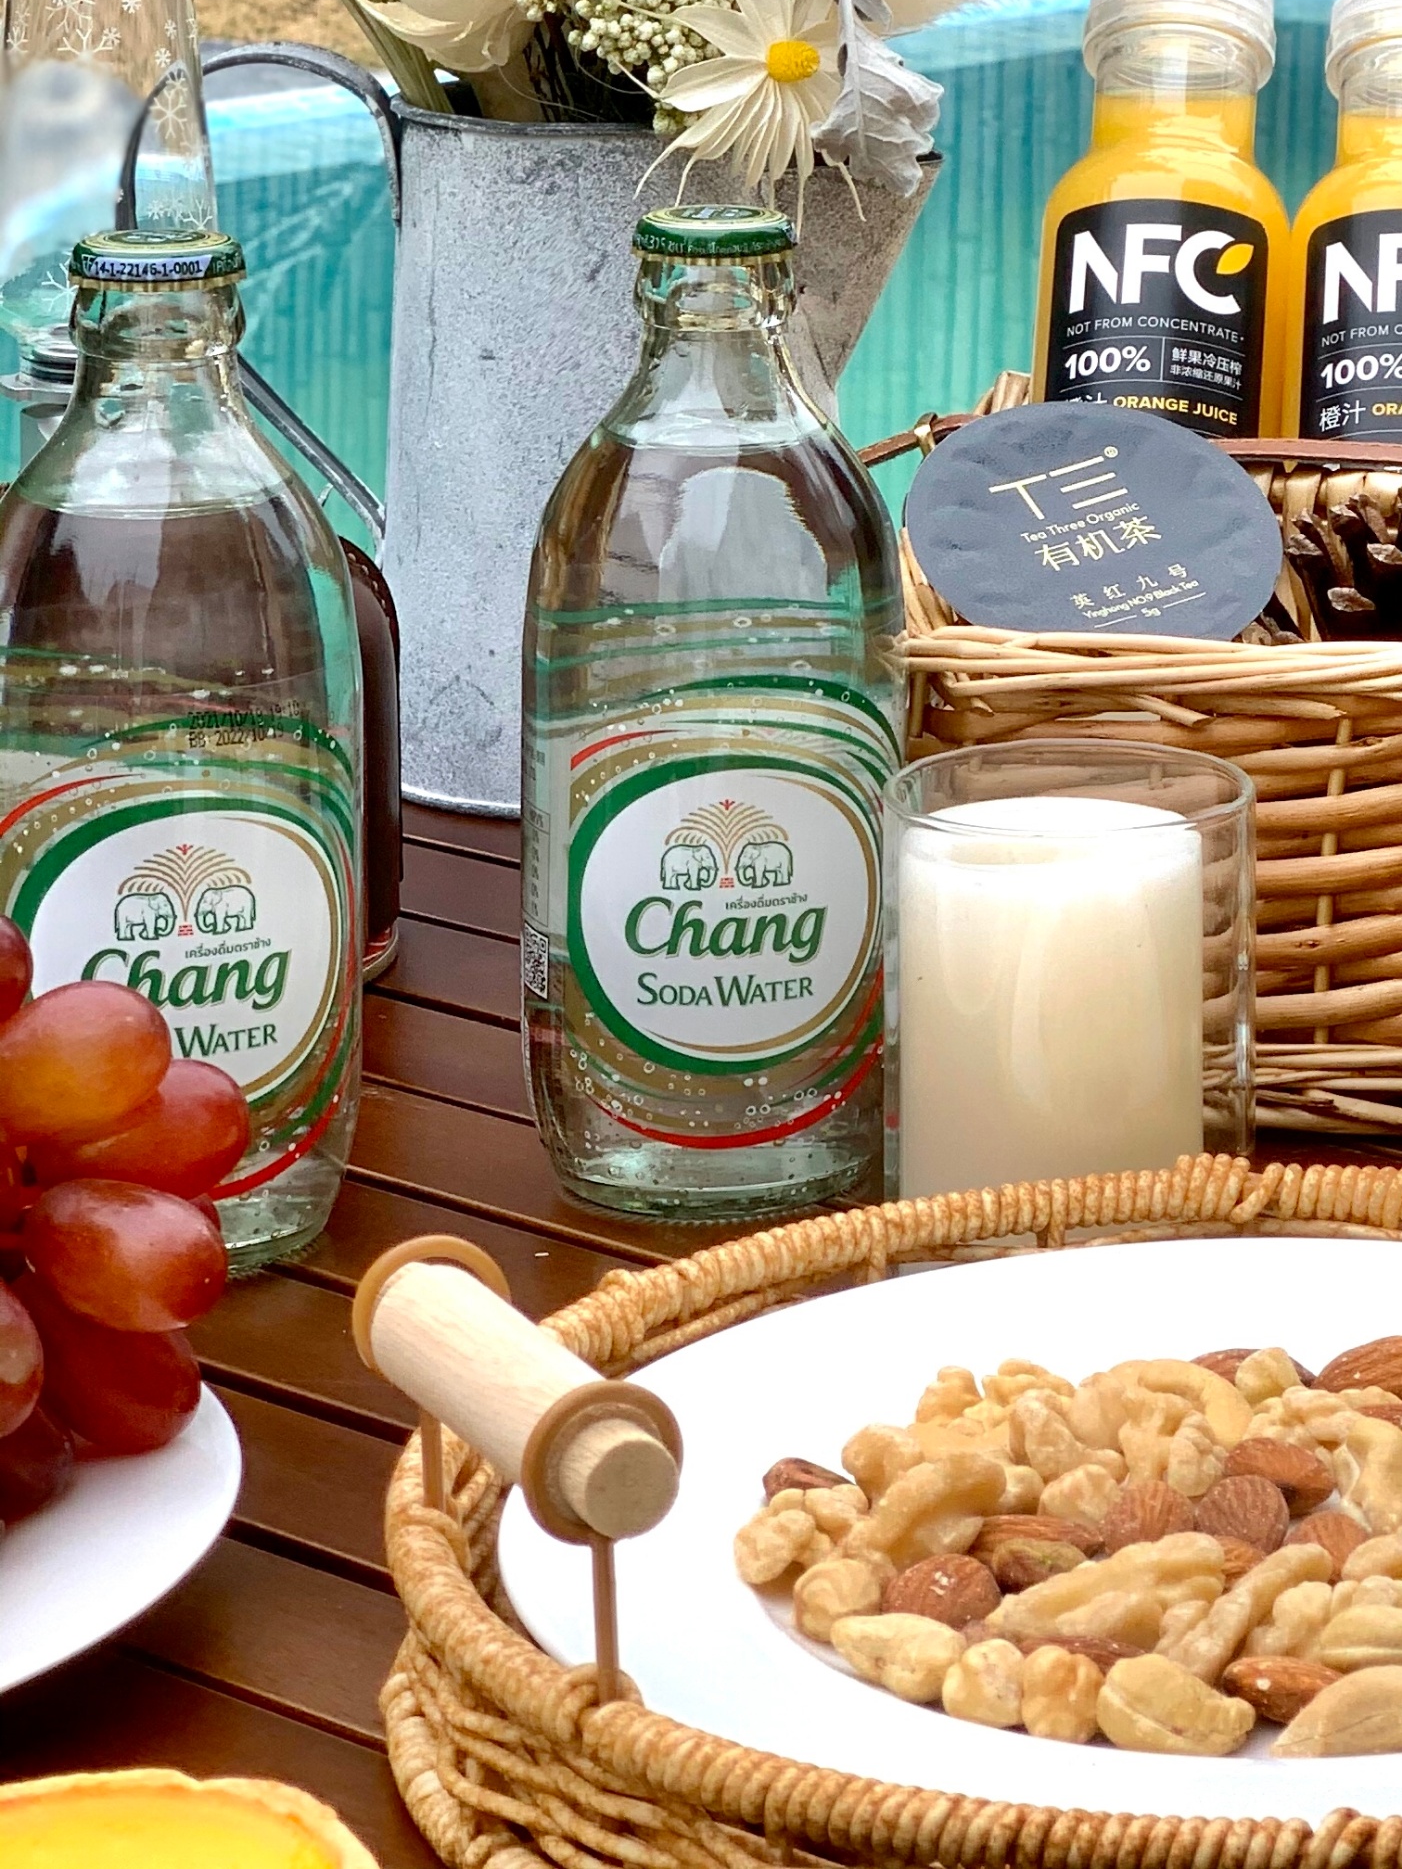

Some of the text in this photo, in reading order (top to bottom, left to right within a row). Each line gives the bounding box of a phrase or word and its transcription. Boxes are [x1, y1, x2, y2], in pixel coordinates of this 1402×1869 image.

[1068, 223, 1243, 315] NFC
[1066, 316, 1239, 343] NOT FROM CONCENTRATE
[1321, 331, 1346, 347] NOT
[1350, 325, 1390, 340] FROM
[1064, 345, 1151, 380] 100%
[1171, 347, 1243, 376] 鲜果冷压榨
[1113, 395, 1189, 413] ORANGE
[1192, 403, 1238, 425] JUICE
[1319, 400, 1366, 432] 橙汁
[1020, 502, 1140, 543] Tea Three Organic
[1034, 516, 1162, 571] 有机茶
[1153, 585, 1182, 599] Black
[1178, 580, 1199, 591] Tea
[725, 893, 808, 911] เครื่องดื่มตราช้าง
[624, 896, 828, 966] Chang
[184, 937, 272, 959] เครื่องดื่มตราช้าง
